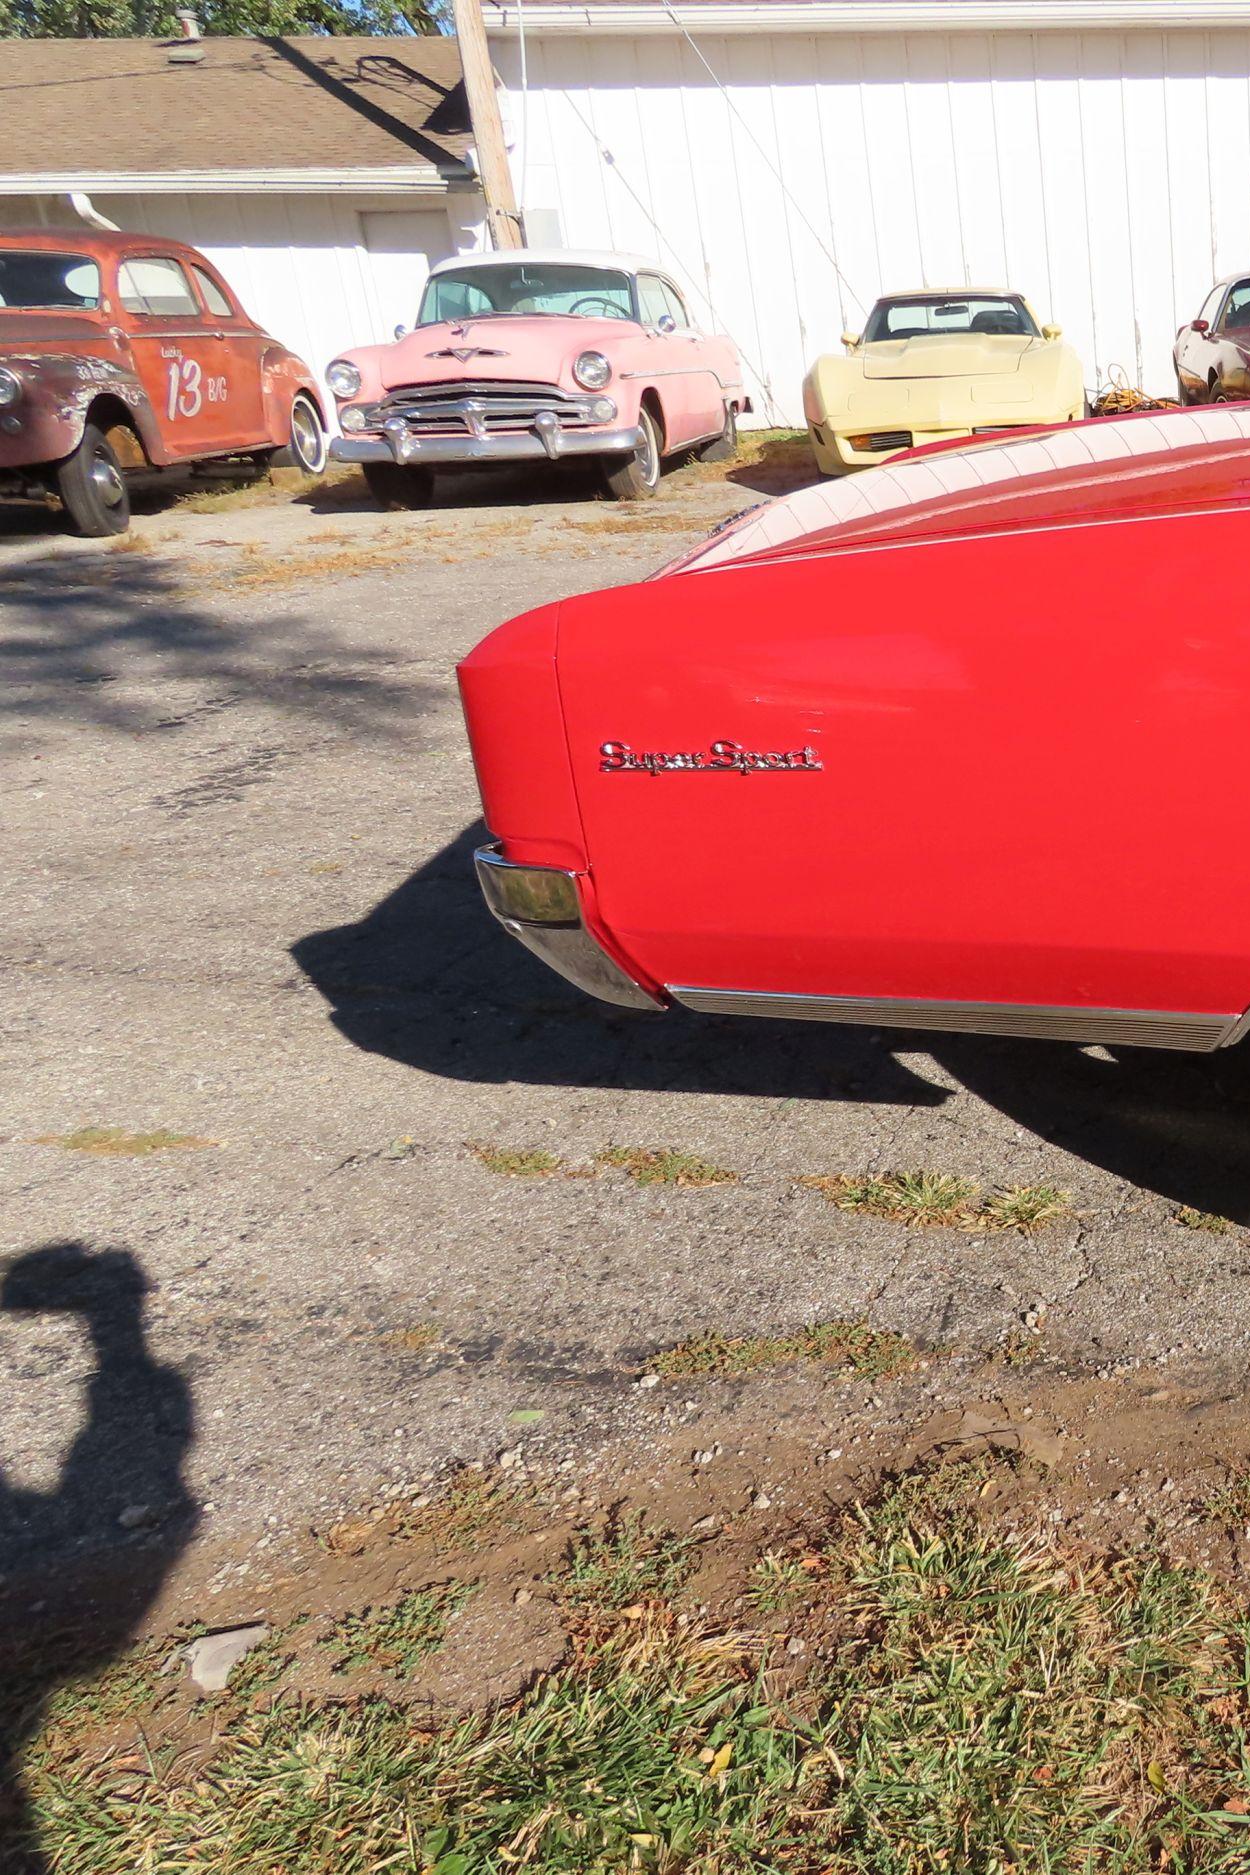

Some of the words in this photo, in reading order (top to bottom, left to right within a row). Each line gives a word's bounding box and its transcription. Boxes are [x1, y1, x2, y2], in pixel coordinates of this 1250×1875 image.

[168, 359, 202, 421] 13
[599, 740, 705, 776] Super
[709, 740, 820, 776] Sport
